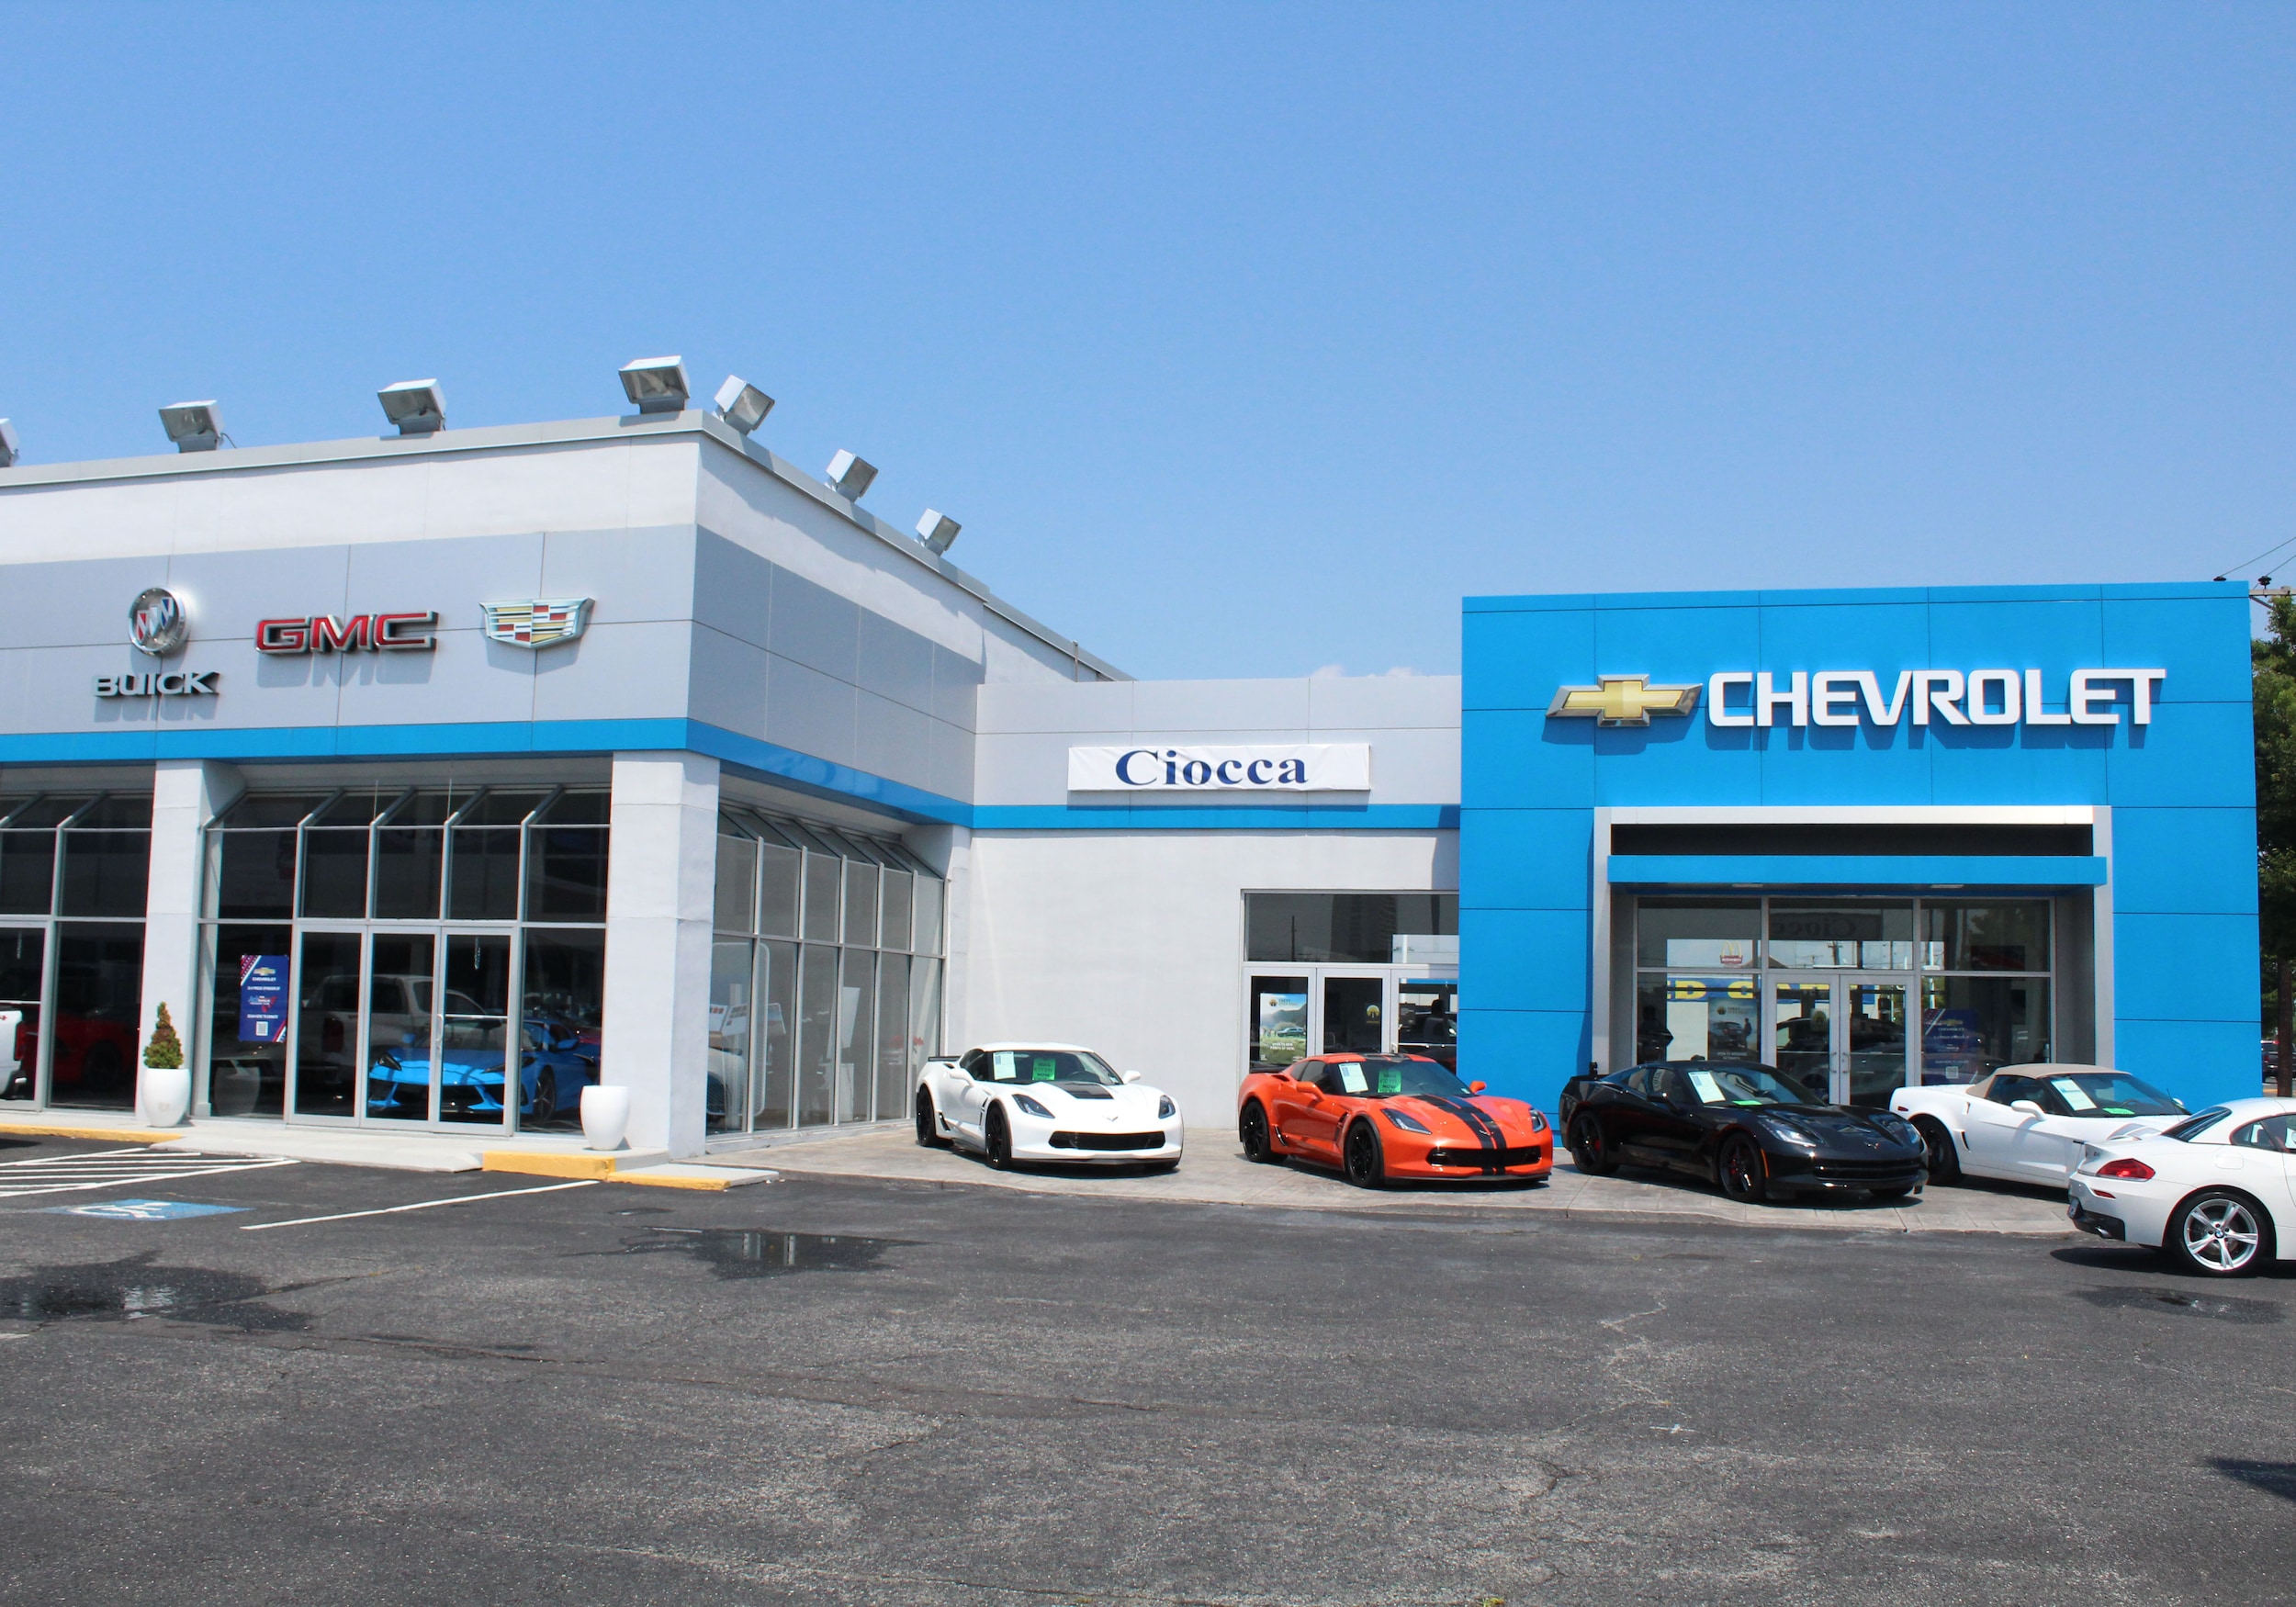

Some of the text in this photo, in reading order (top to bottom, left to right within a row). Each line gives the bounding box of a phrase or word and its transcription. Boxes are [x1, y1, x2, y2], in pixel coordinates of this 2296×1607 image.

[255, 610, 438, 653] GMC
[95, 670, 218, 697] BUICK
[1708, 668, 2167, 726] CHEVROLET
[1115, 749, 1310, 786] Ciocca
